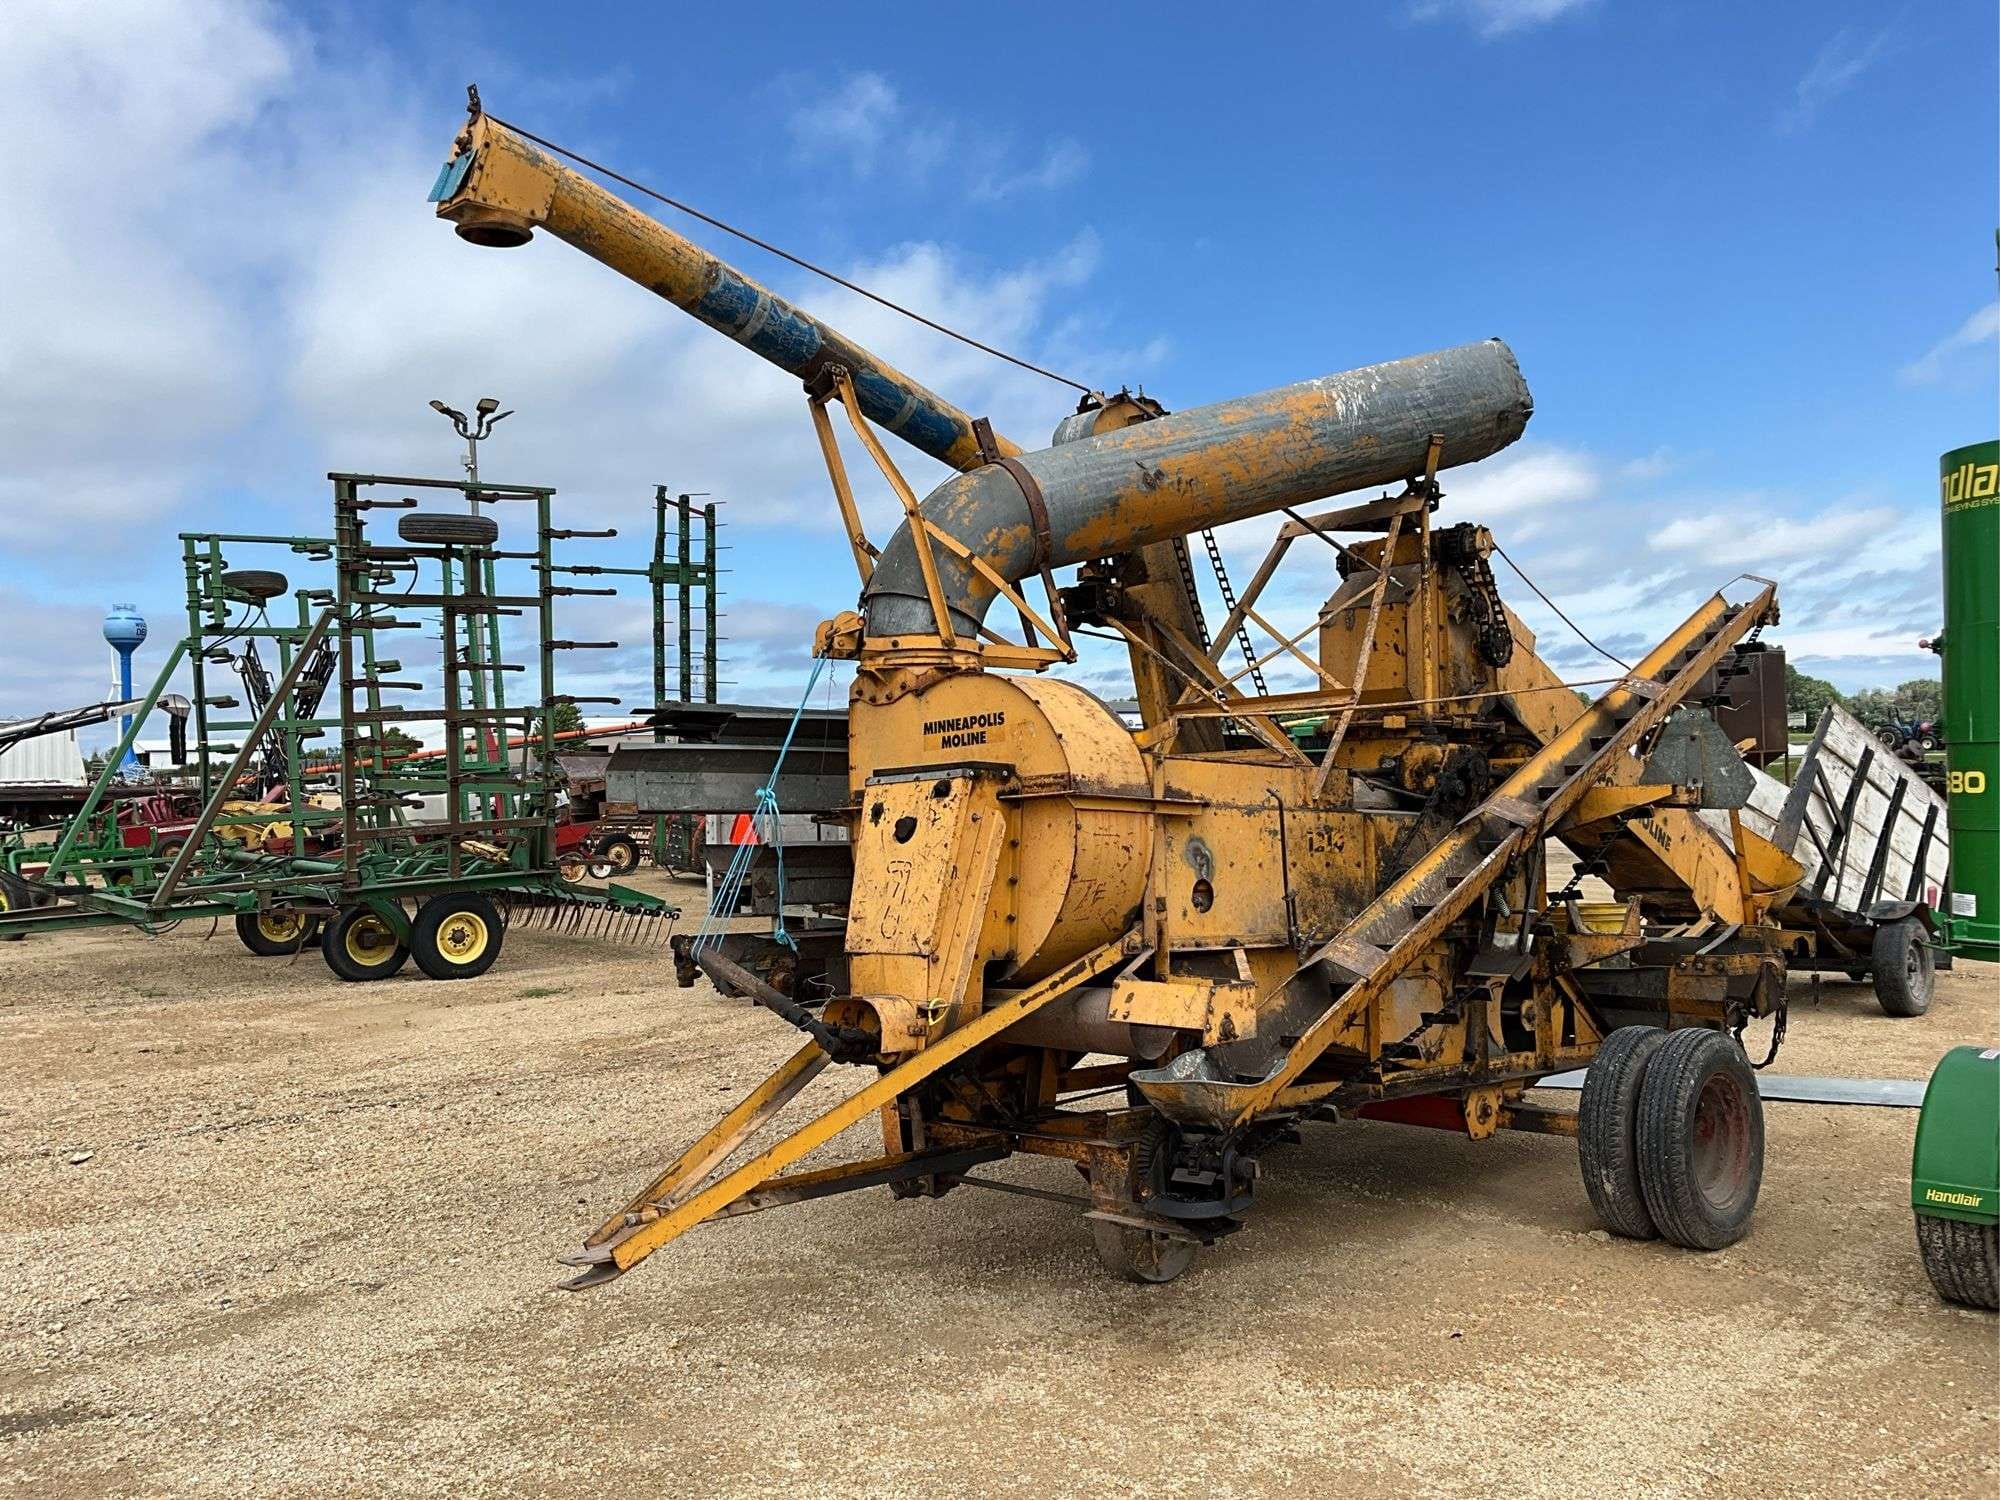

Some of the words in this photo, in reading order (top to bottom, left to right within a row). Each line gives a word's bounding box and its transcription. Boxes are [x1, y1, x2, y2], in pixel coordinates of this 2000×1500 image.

[1942, 463, 2000, 504] ndla
[923, 711, 1005, 735] MINNEAPOLIS
[941, 731, 987, 749] MOLINE
[1946, 771, 1986, 793] 80
[1639, 818, 1672, 852] OLINE
[1925, 1188, 1984, 1207] Handlair
